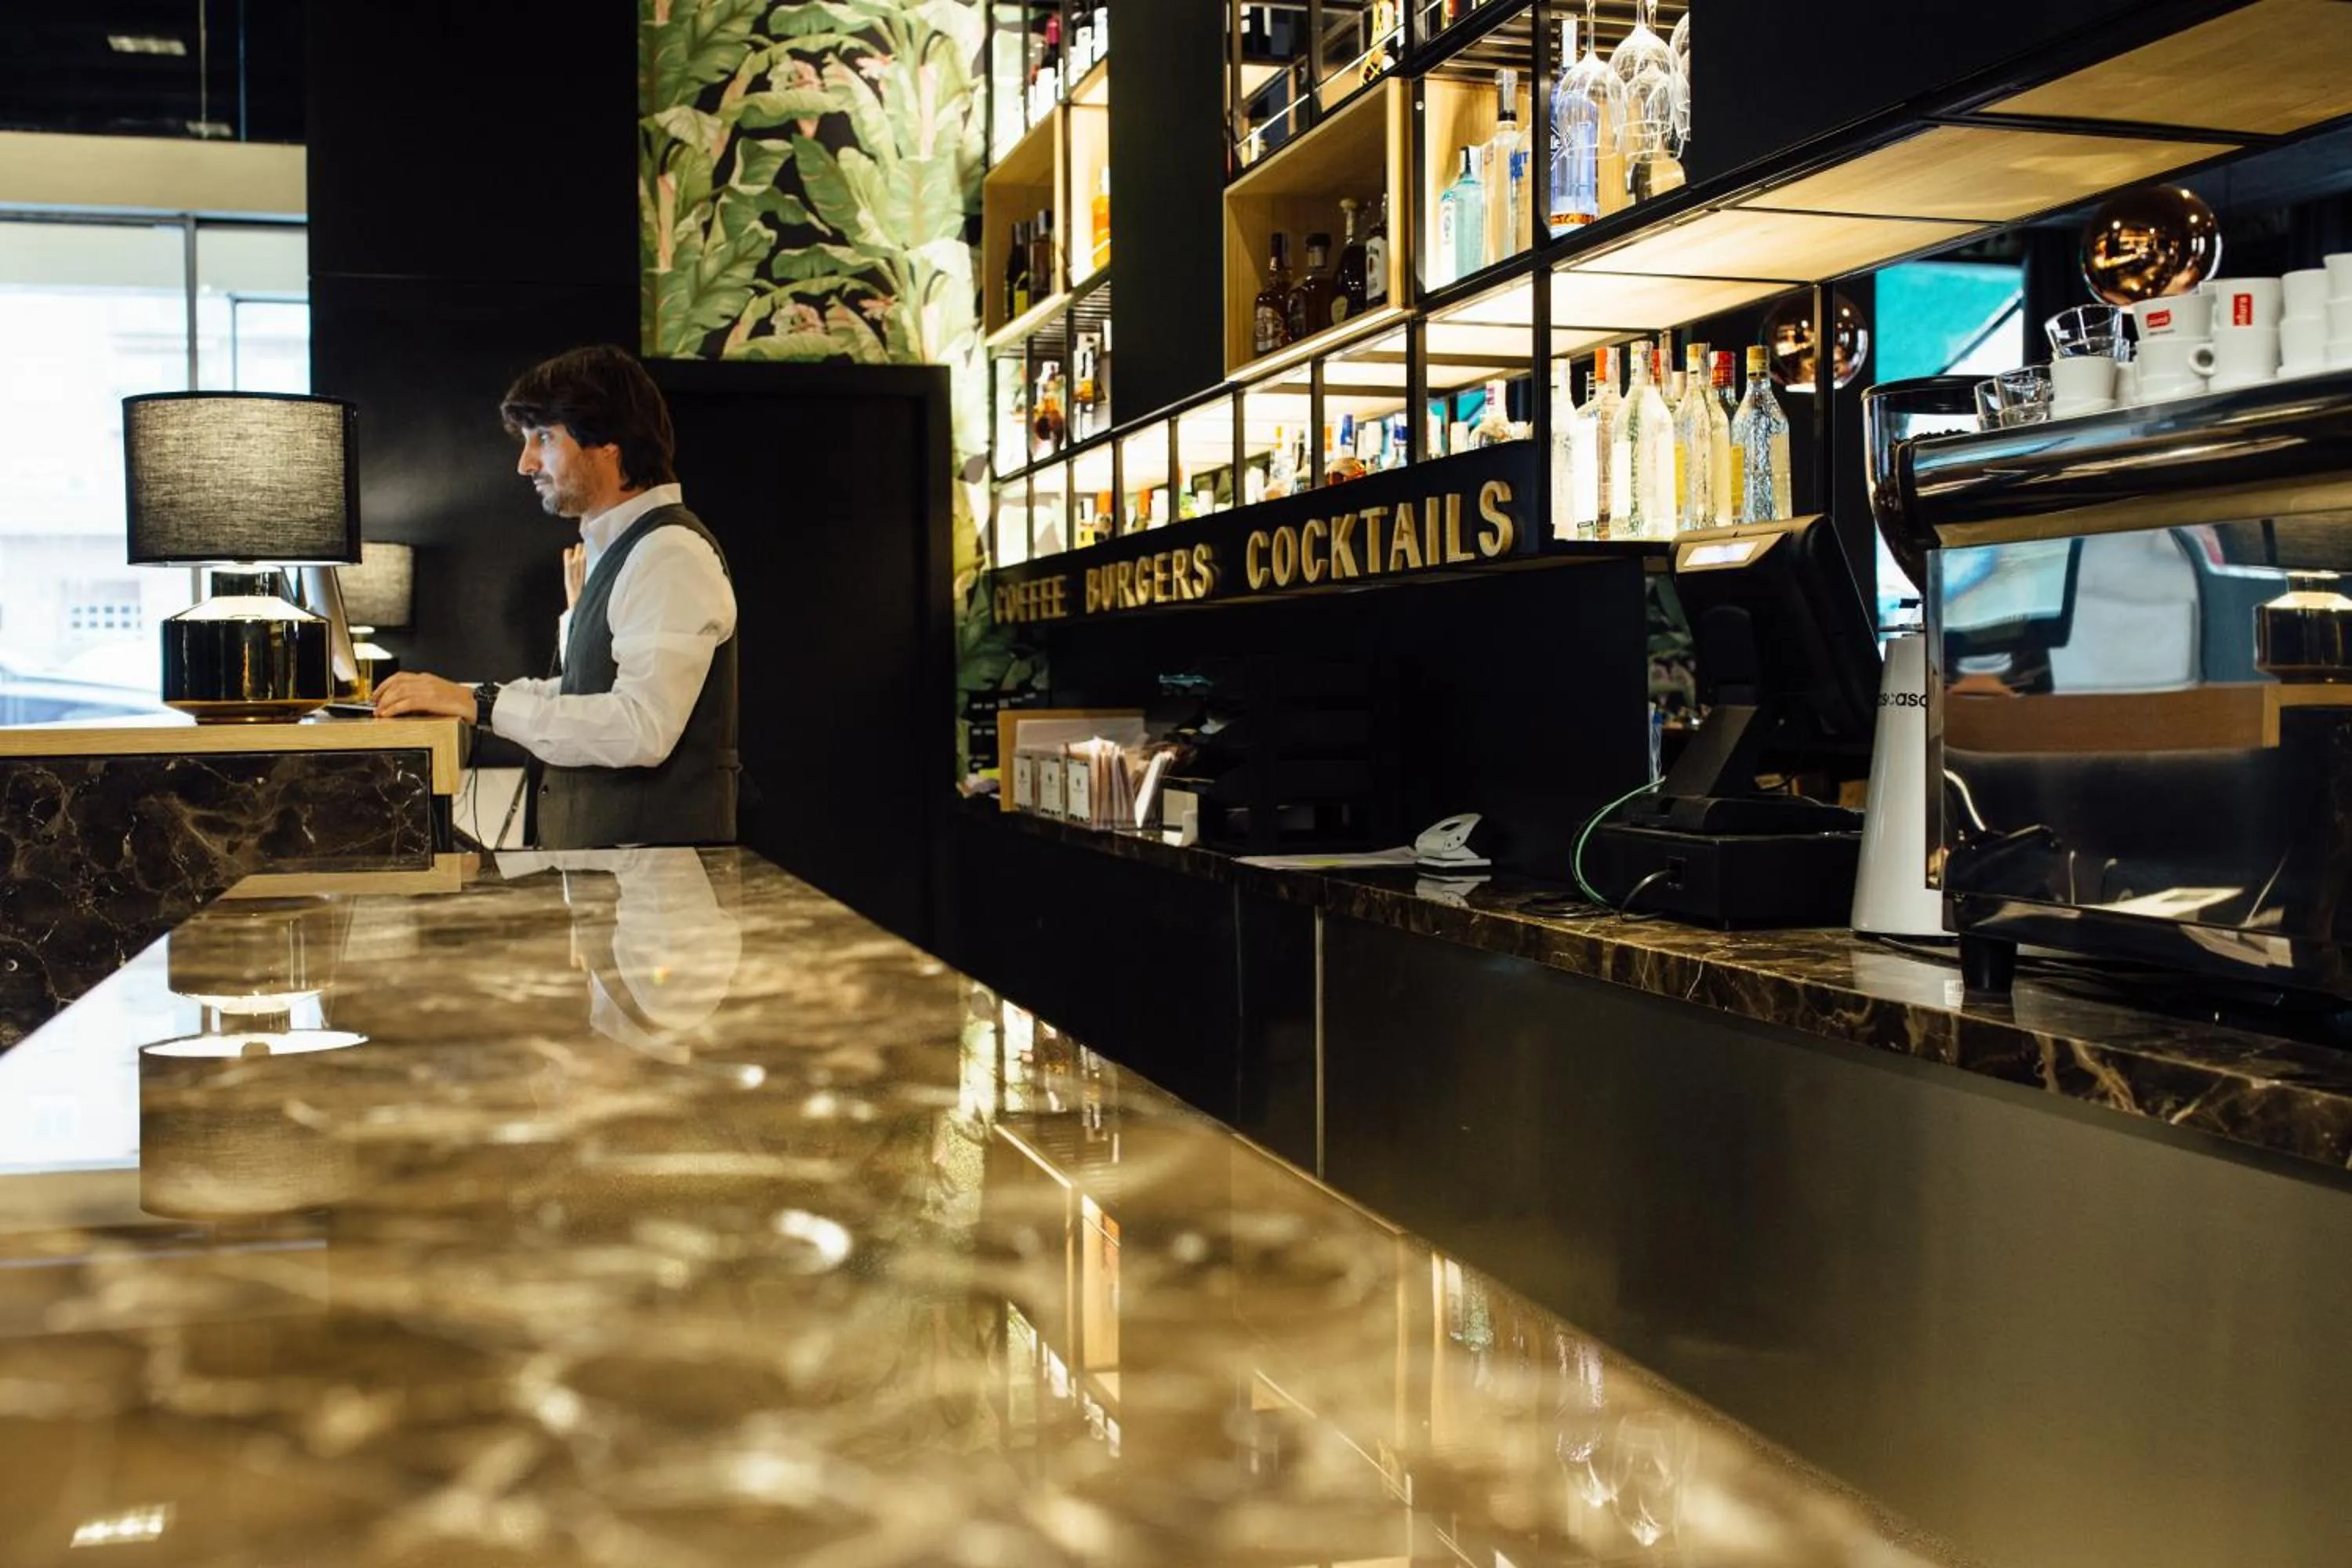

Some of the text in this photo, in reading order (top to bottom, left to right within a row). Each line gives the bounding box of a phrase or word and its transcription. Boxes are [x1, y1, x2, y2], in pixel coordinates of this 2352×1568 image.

[994, 480, 1513, 624] COFFEE BURGERS COCKTAILS
